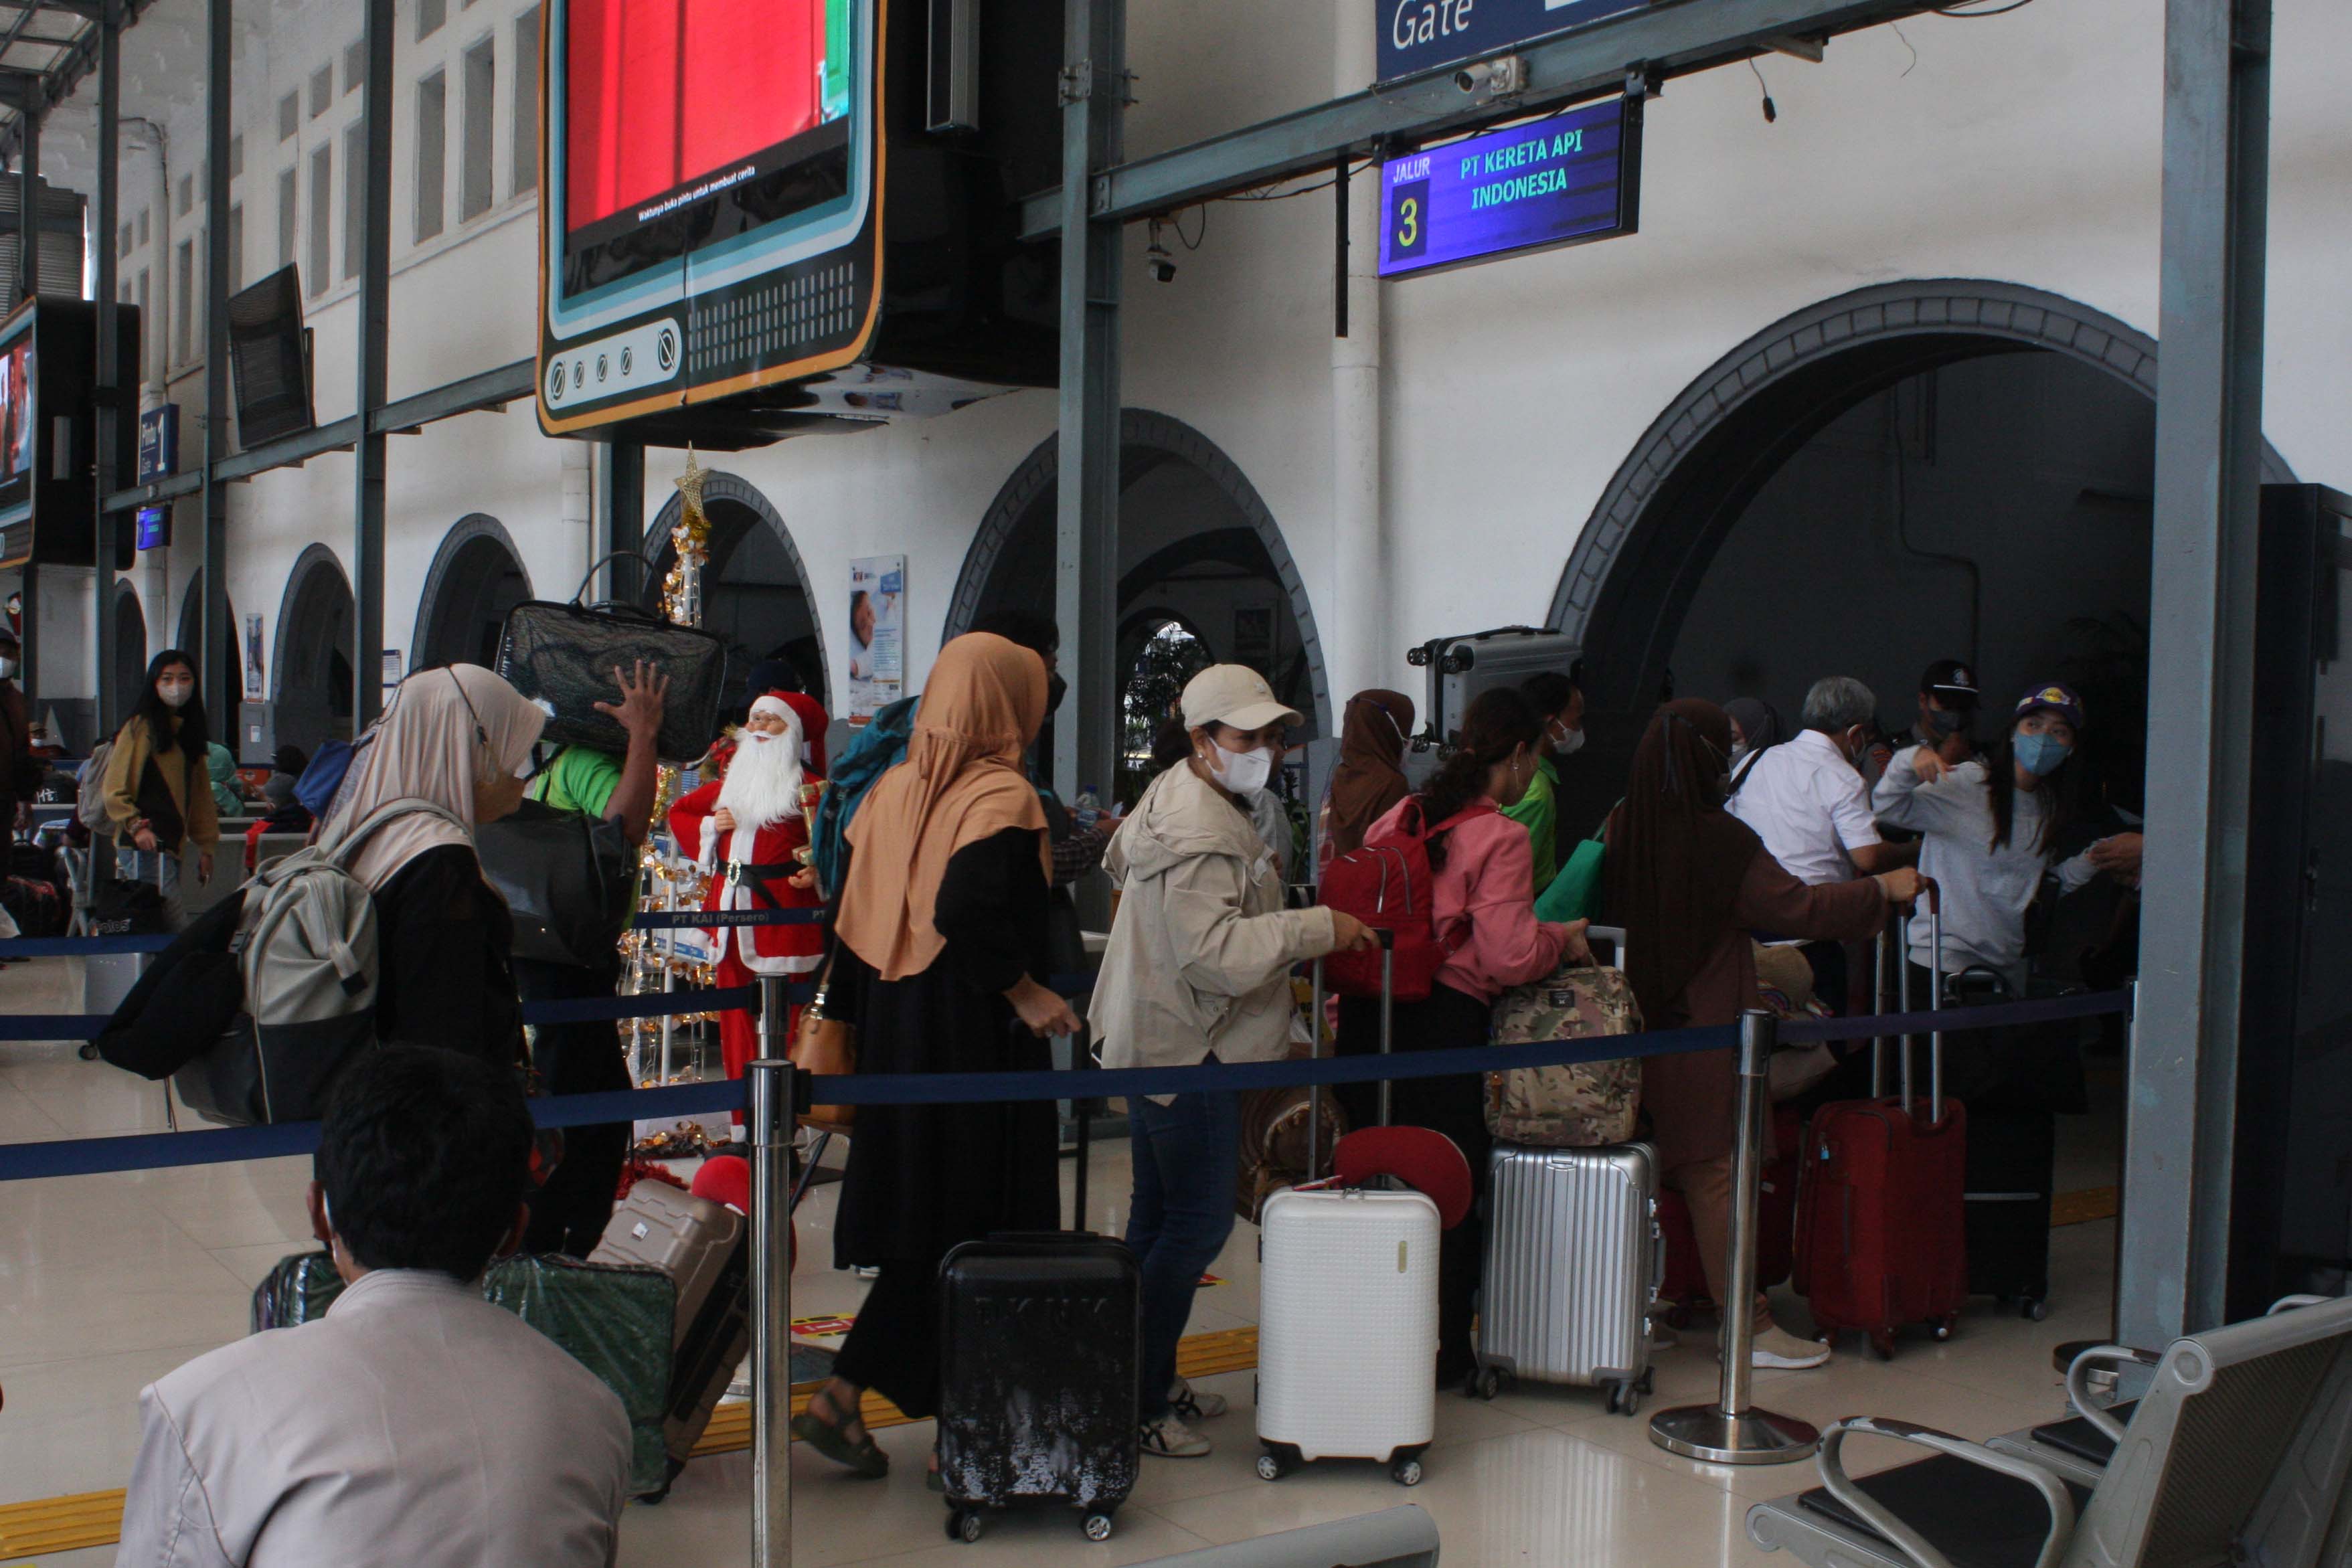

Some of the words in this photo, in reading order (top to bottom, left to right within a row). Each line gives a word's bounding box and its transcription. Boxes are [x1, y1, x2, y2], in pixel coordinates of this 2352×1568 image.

[1393, 0, 1473, 50] Gate
[1393, 157, 1430, 183] JALUR
[1460, 155, 1481, 179] PT
[1485, 139, 1547, 174] KERETA
[1551, 129, 1583, 157] API
[639, 203, 664, 222] Waktunya
[664, 197, 678, 211] buka
[677, 192, 693, 207] pintu
[692, 183, 709, 199] untuk
[709, 172, 737, 192] membuat
[737, 165, 755, 181] cerita
[1471, 167, 1568, 209] INDONESIA
[1398, 197, 1418, 247] 3
[672, 914, 687, 924] PT
[692, 913, 713, 924] KAI
[716, 911, 769, 924] (Persero)
